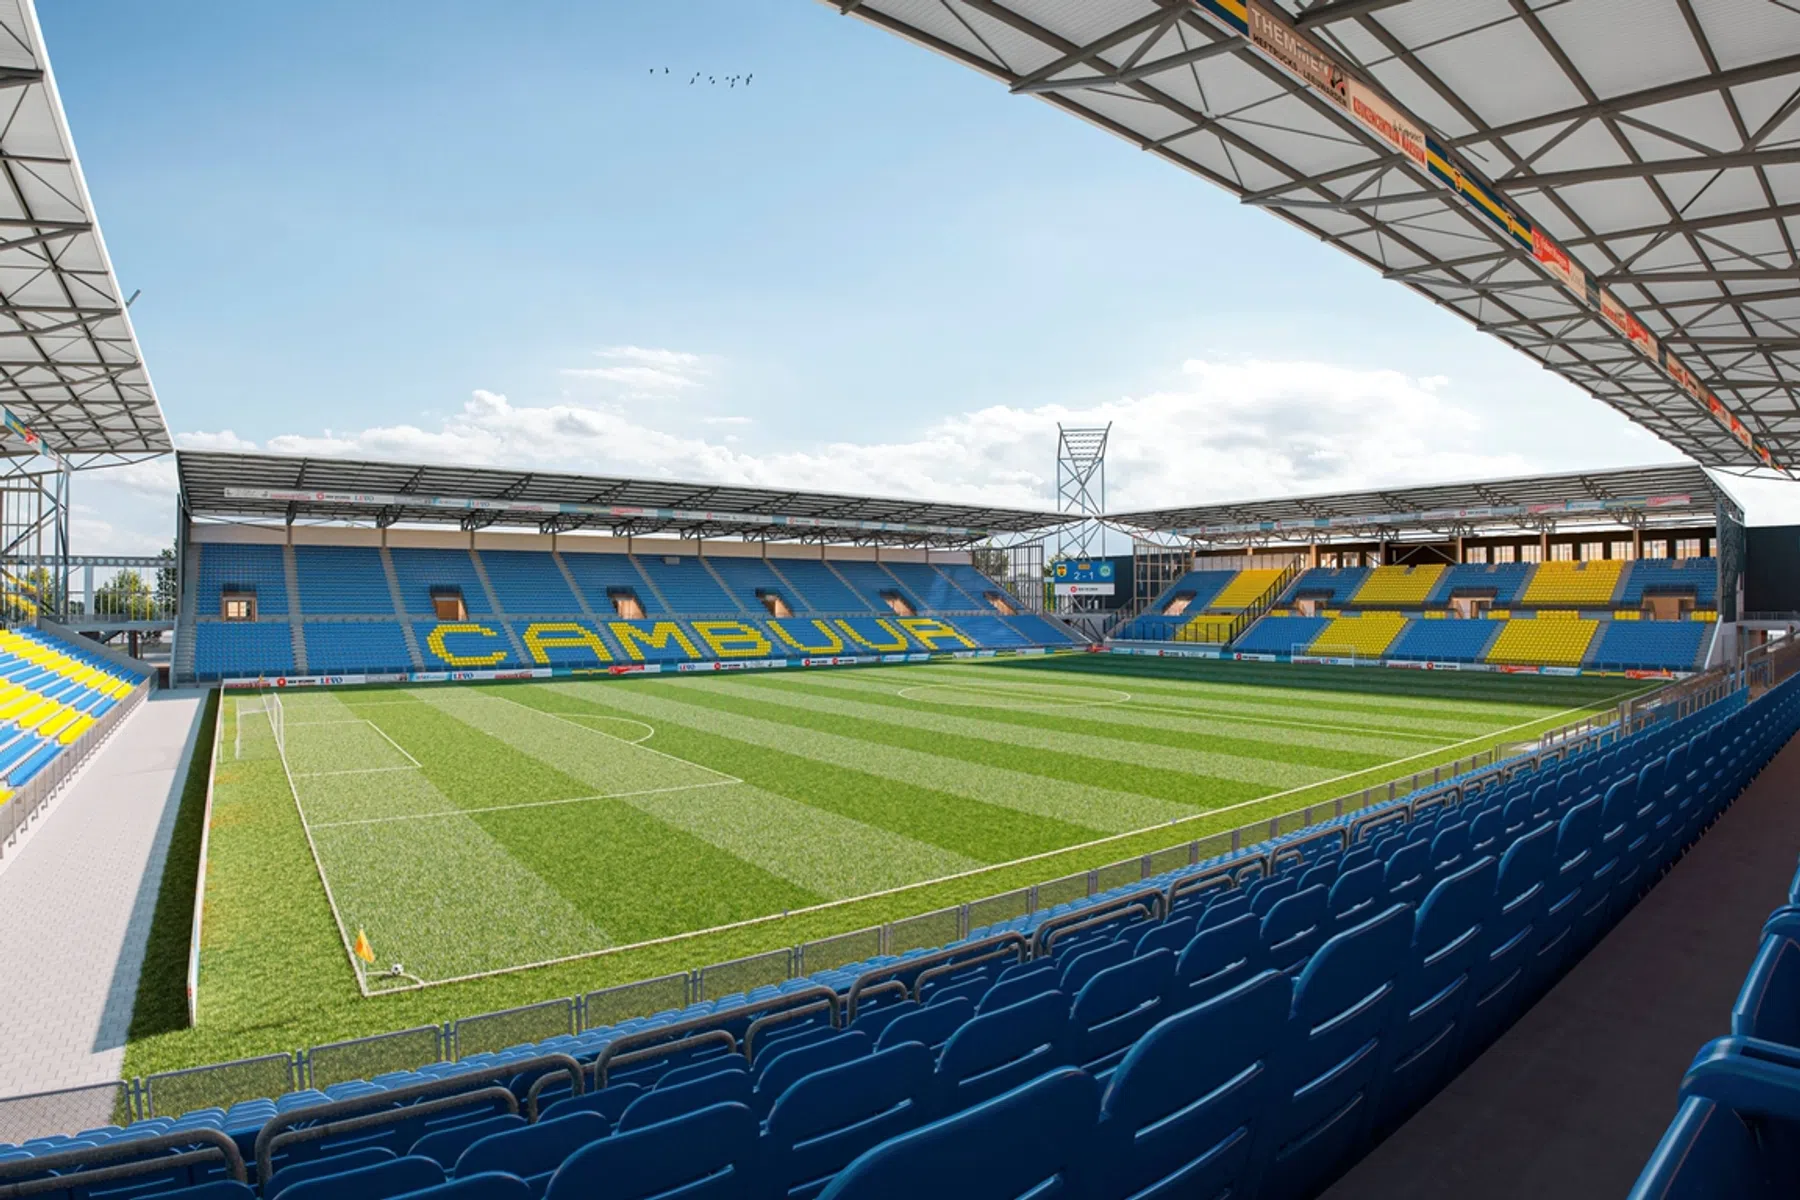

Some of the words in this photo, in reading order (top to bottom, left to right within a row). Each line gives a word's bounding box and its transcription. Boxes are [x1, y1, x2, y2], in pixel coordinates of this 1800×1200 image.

[1073, 571, 1081, 580] 2
[1089, 571, 1094, 580] 1
[427, 618, 977, 666] CAMBUUR
[320, 676, 344, 685] LEVO
[453, 672, 474, 680] LEVO
